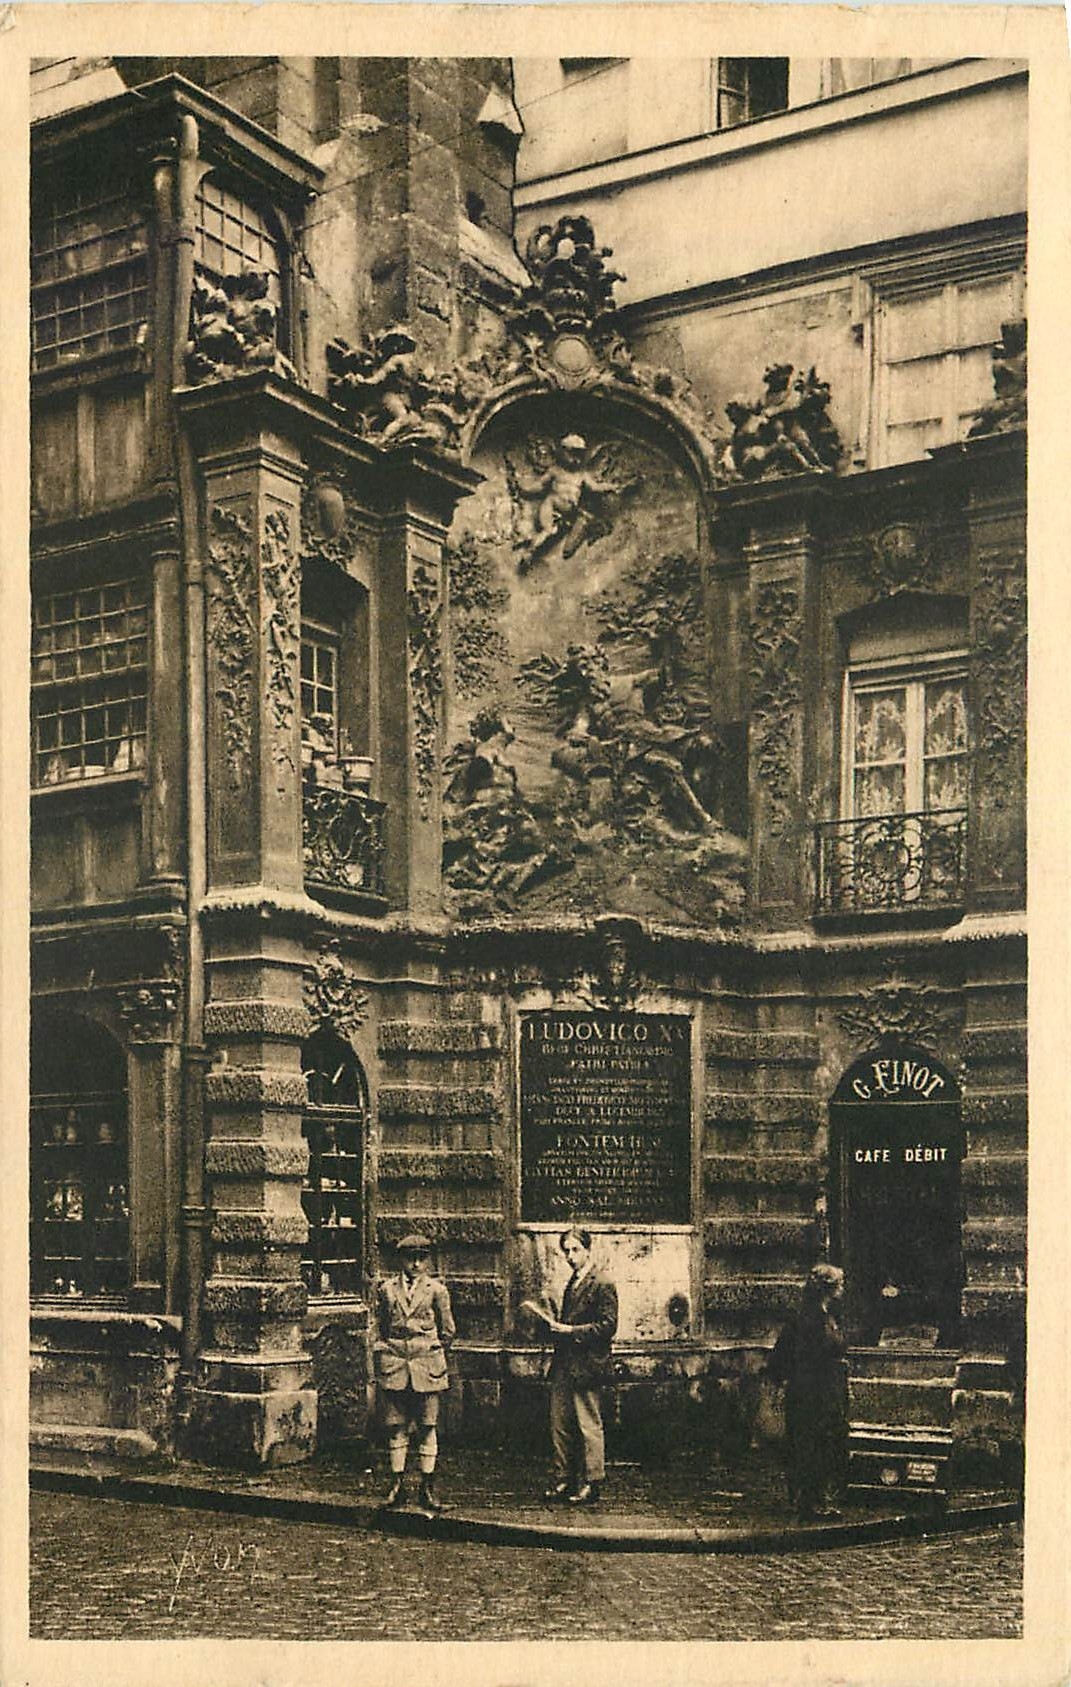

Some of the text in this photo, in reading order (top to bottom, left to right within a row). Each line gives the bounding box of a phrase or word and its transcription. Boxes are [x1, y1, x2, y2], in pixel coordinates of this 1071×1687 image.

[529, 1022, 648, 1041] LUDOVICO
[871, 1060, 945, 1098] FINOT
[855, 1143, 947, 1162] CAFE DÉBIT
